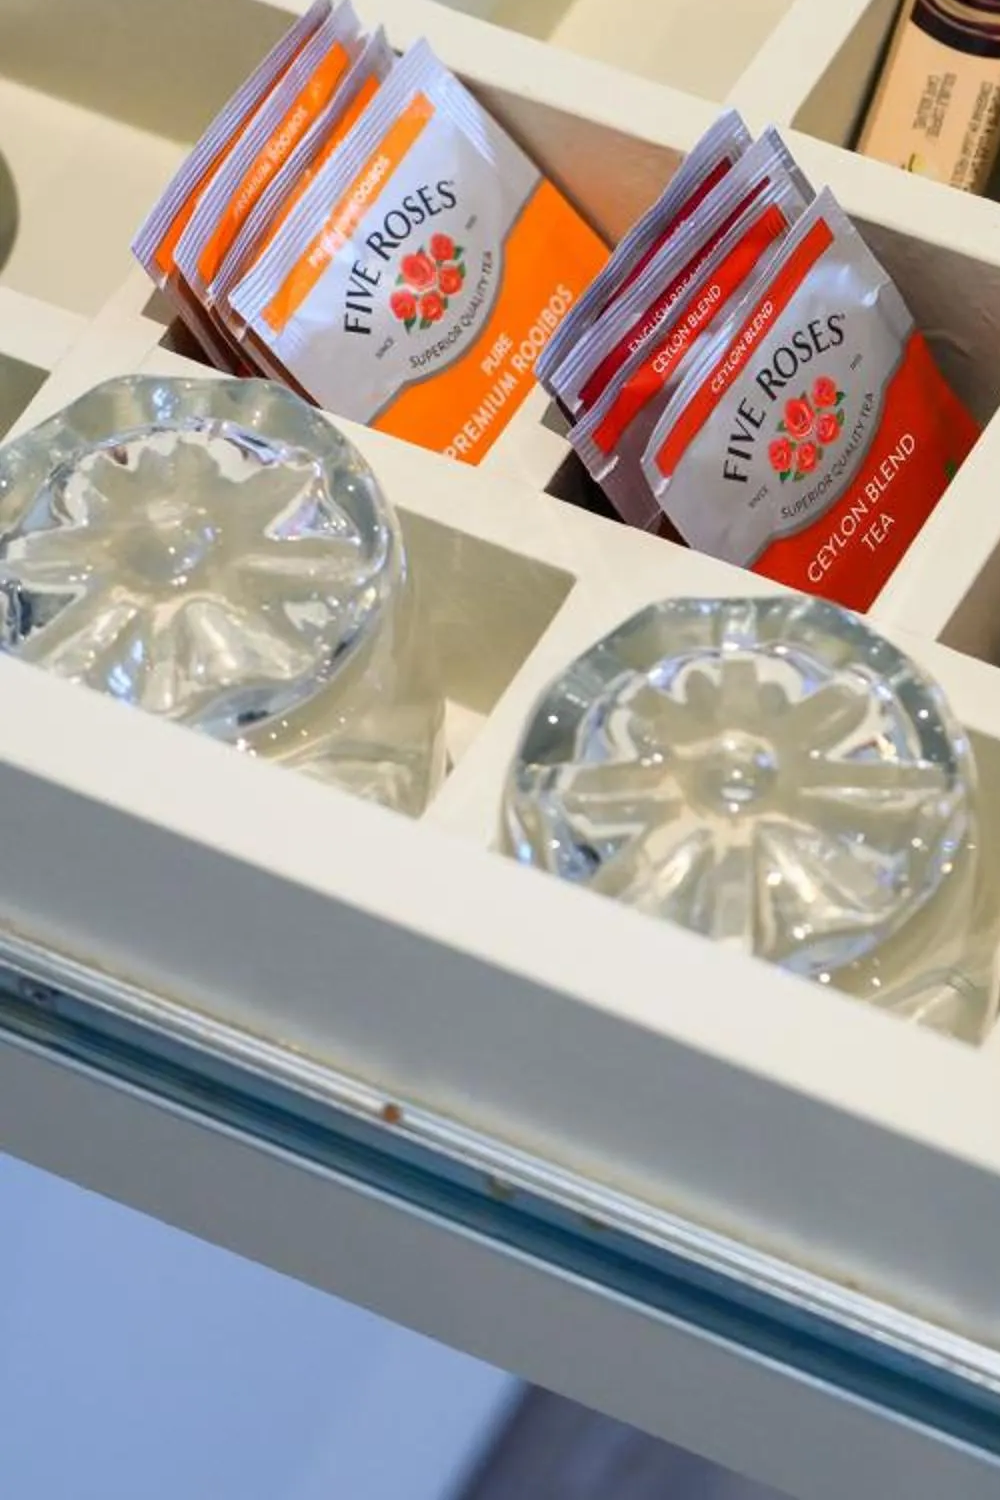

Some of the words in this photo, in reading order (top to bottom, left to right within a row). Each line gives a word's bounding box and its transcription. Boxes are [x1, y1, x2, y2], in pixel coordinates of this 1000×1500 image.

[344, 260, 381, 335] FIVE
[366, 180, 457, 261] ROSES
[409, 325, 464, 368] SUPERIOR
[461, 272, 490, 328] QUALITY
[442, 372, 519, 460] PREMIUM
[511, 283, 573, 374] ROOIBOS
[480, 332, 514, 376] PURE
[652, 323, 690, 374] CEYLON
[687, 285, 721, 328] BLEND
[711, 342, 746, 393] CEYLON
[743, 301, 773, 344] BLEND
[723, 398, 766, 483] FIVE
[755, 314, 845, 401] ROSES
[780, 473, 834, 519] SUPERIOR
[832, 417, 868, 475] QUALITY
[861, 392, 873, 418] TEA
[806, 500, 869, 582] CEYLON
[864, 433, 916, 501] BLEND
[861, 512, 895, 552] TEA
